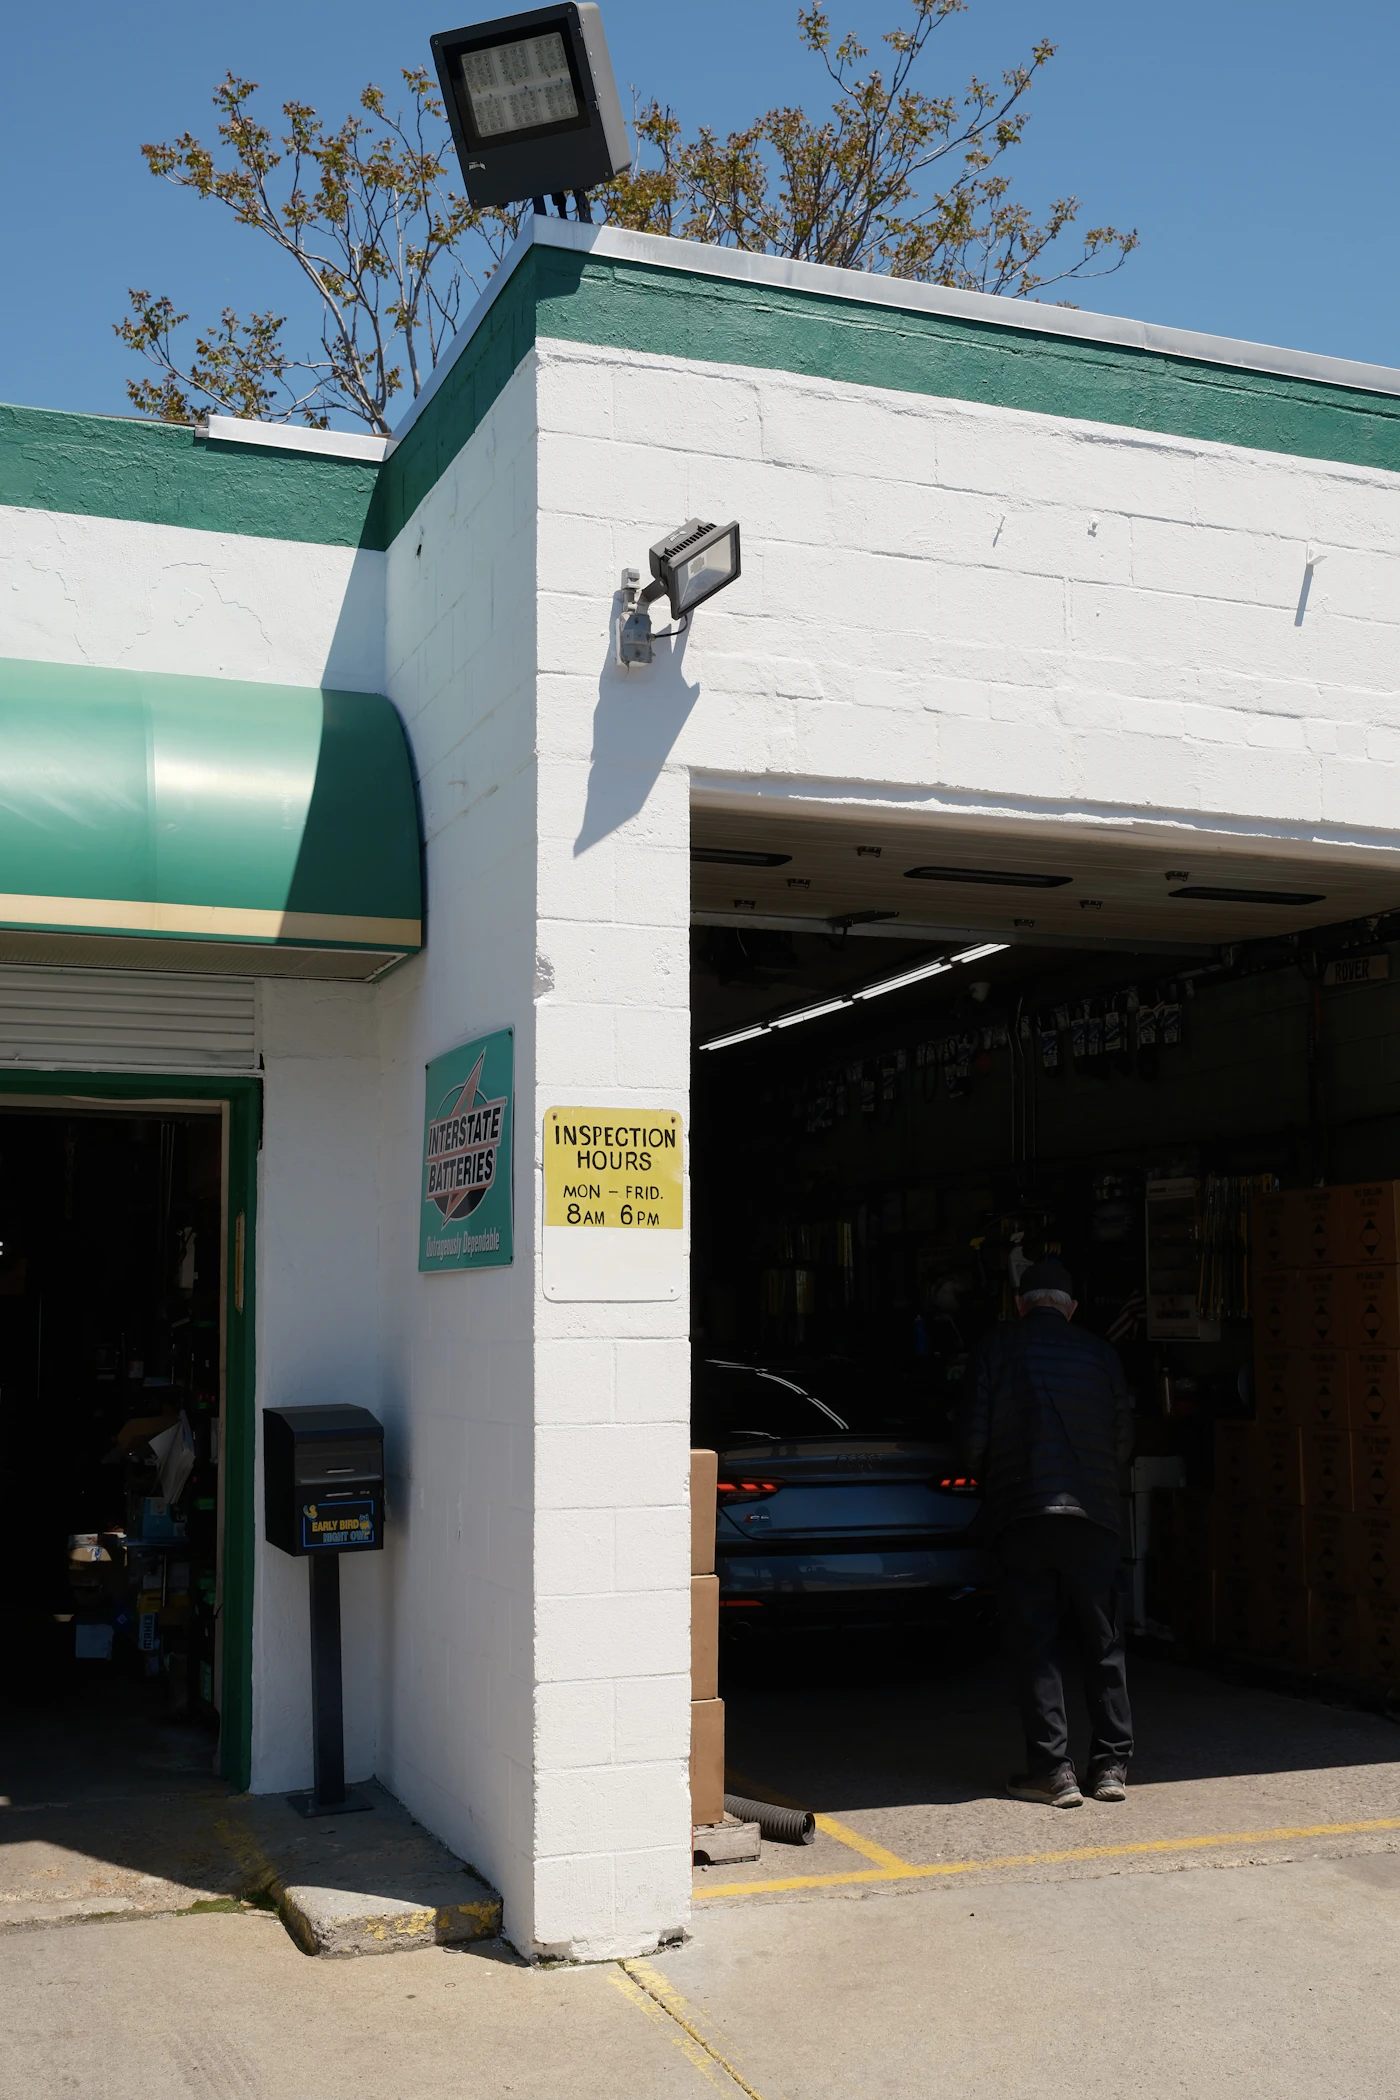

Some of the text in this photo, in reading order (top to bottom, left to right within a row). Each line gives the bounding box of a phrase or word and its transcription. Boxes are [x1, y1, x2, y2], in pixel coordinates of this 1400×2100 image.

[428, 1107, 501, 1156] INTERSTATE
[555, 1125, 676, 1148] INSPECTION
[428, 1149, 494, 1193] BATTERIES
[577, 1150, 652, 1171] HOURS
[563, 1184, 601, 1199] MON
[626, 1185, 664, 1200] FRID.
[426, 1227, 500, 1260] Outrageously Dependable
[312, 1519, 359, 1532] EARLY BIRD
[323, 1530, 369, 1543] NIGHT OWL
[143, 1614, 153, 1650] MAHLE
